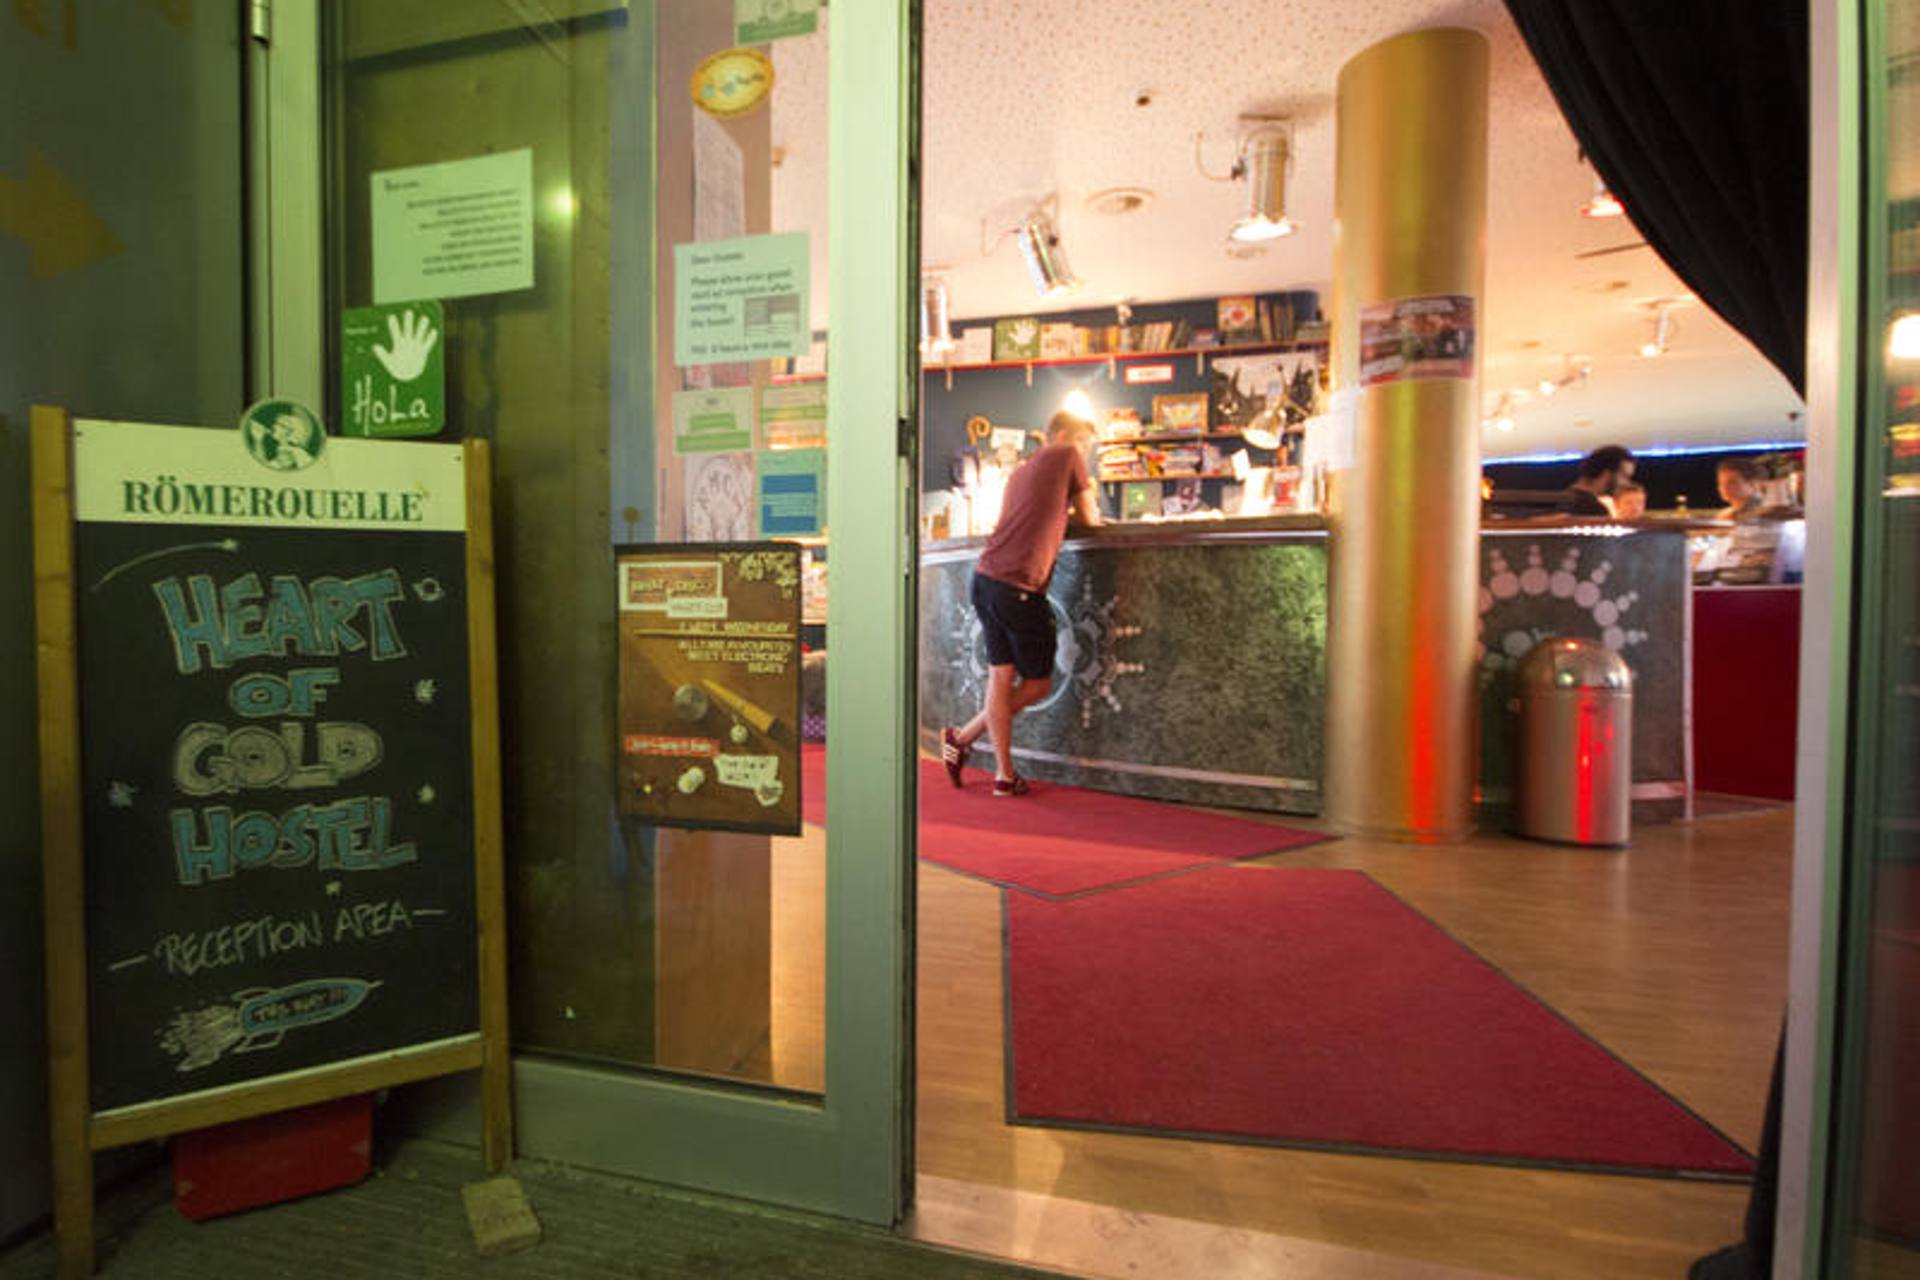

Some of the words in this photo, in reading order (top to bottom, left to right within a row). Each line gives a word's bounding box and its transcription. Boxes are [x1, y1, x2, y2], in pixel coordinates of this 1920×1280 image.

[123, 475, 423, 521] RÖMERQUELLE
[152, 569, 406, 674] HEART
[229, 668, 340, 717] OF
[175, 721, 383, 795] GOLD
[171, 797, 418, 884] HOSTEL
[155, 916, 323, 974] RECEPTION
[334, 901, 412, 942] AREA
